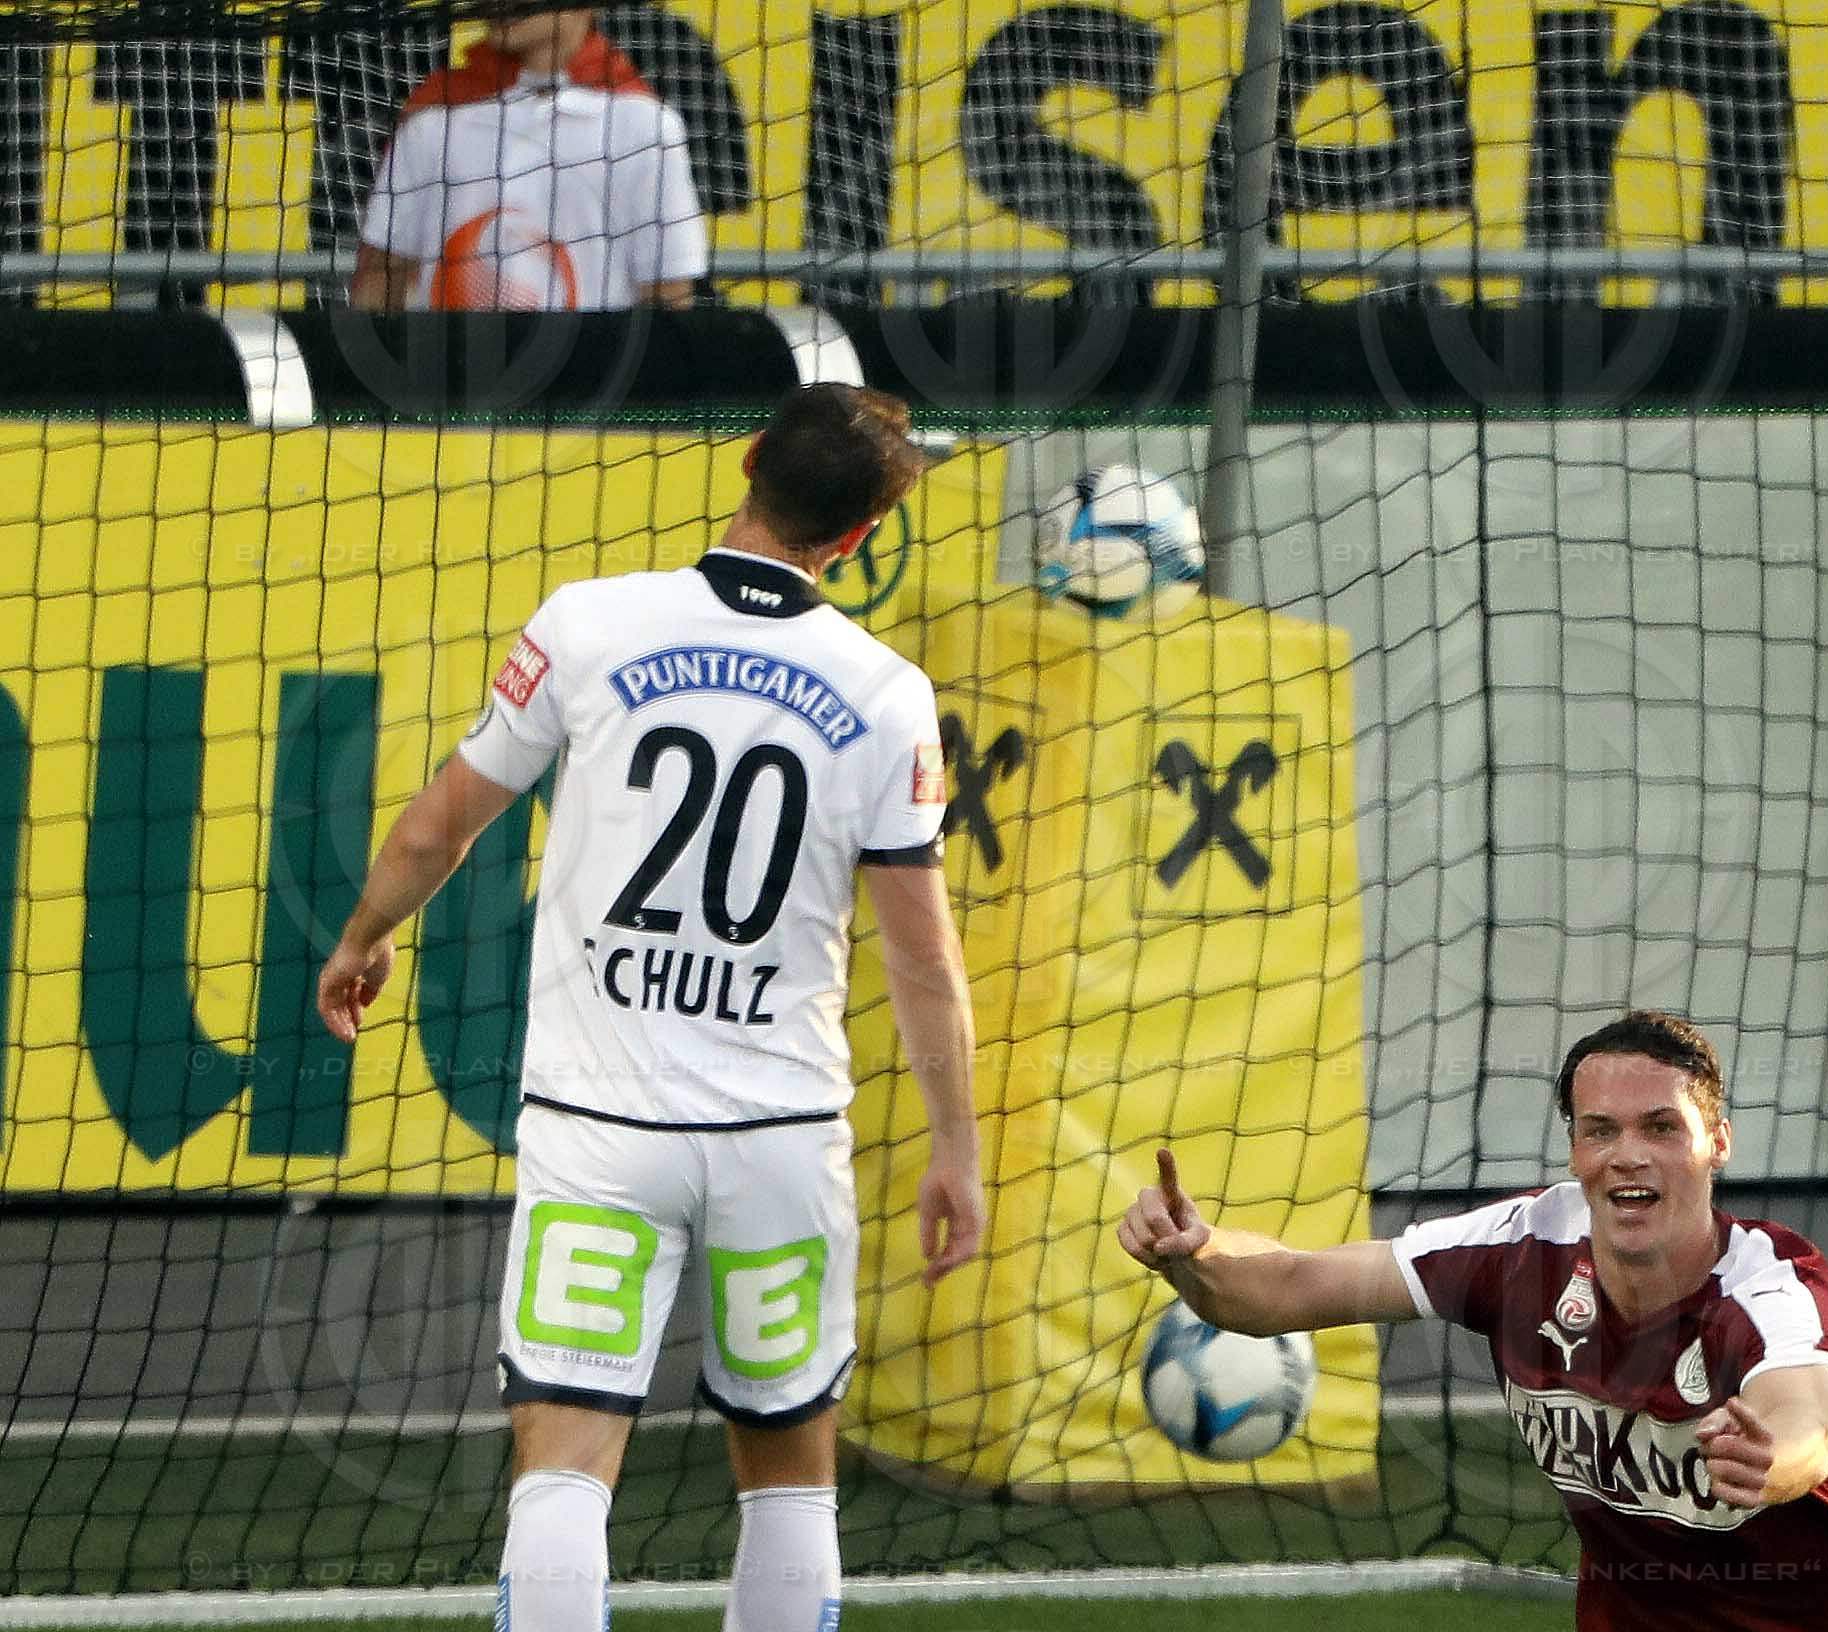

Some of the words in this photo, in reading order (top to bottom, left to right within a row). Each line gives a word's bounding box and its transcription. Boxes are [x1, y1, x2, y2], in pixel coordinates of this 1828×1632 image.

[622, 650, 861, 744] PUNTIGAMER
[601, 726, 808, 945] 20
[583, 937, 780, 1024] CHULZ
